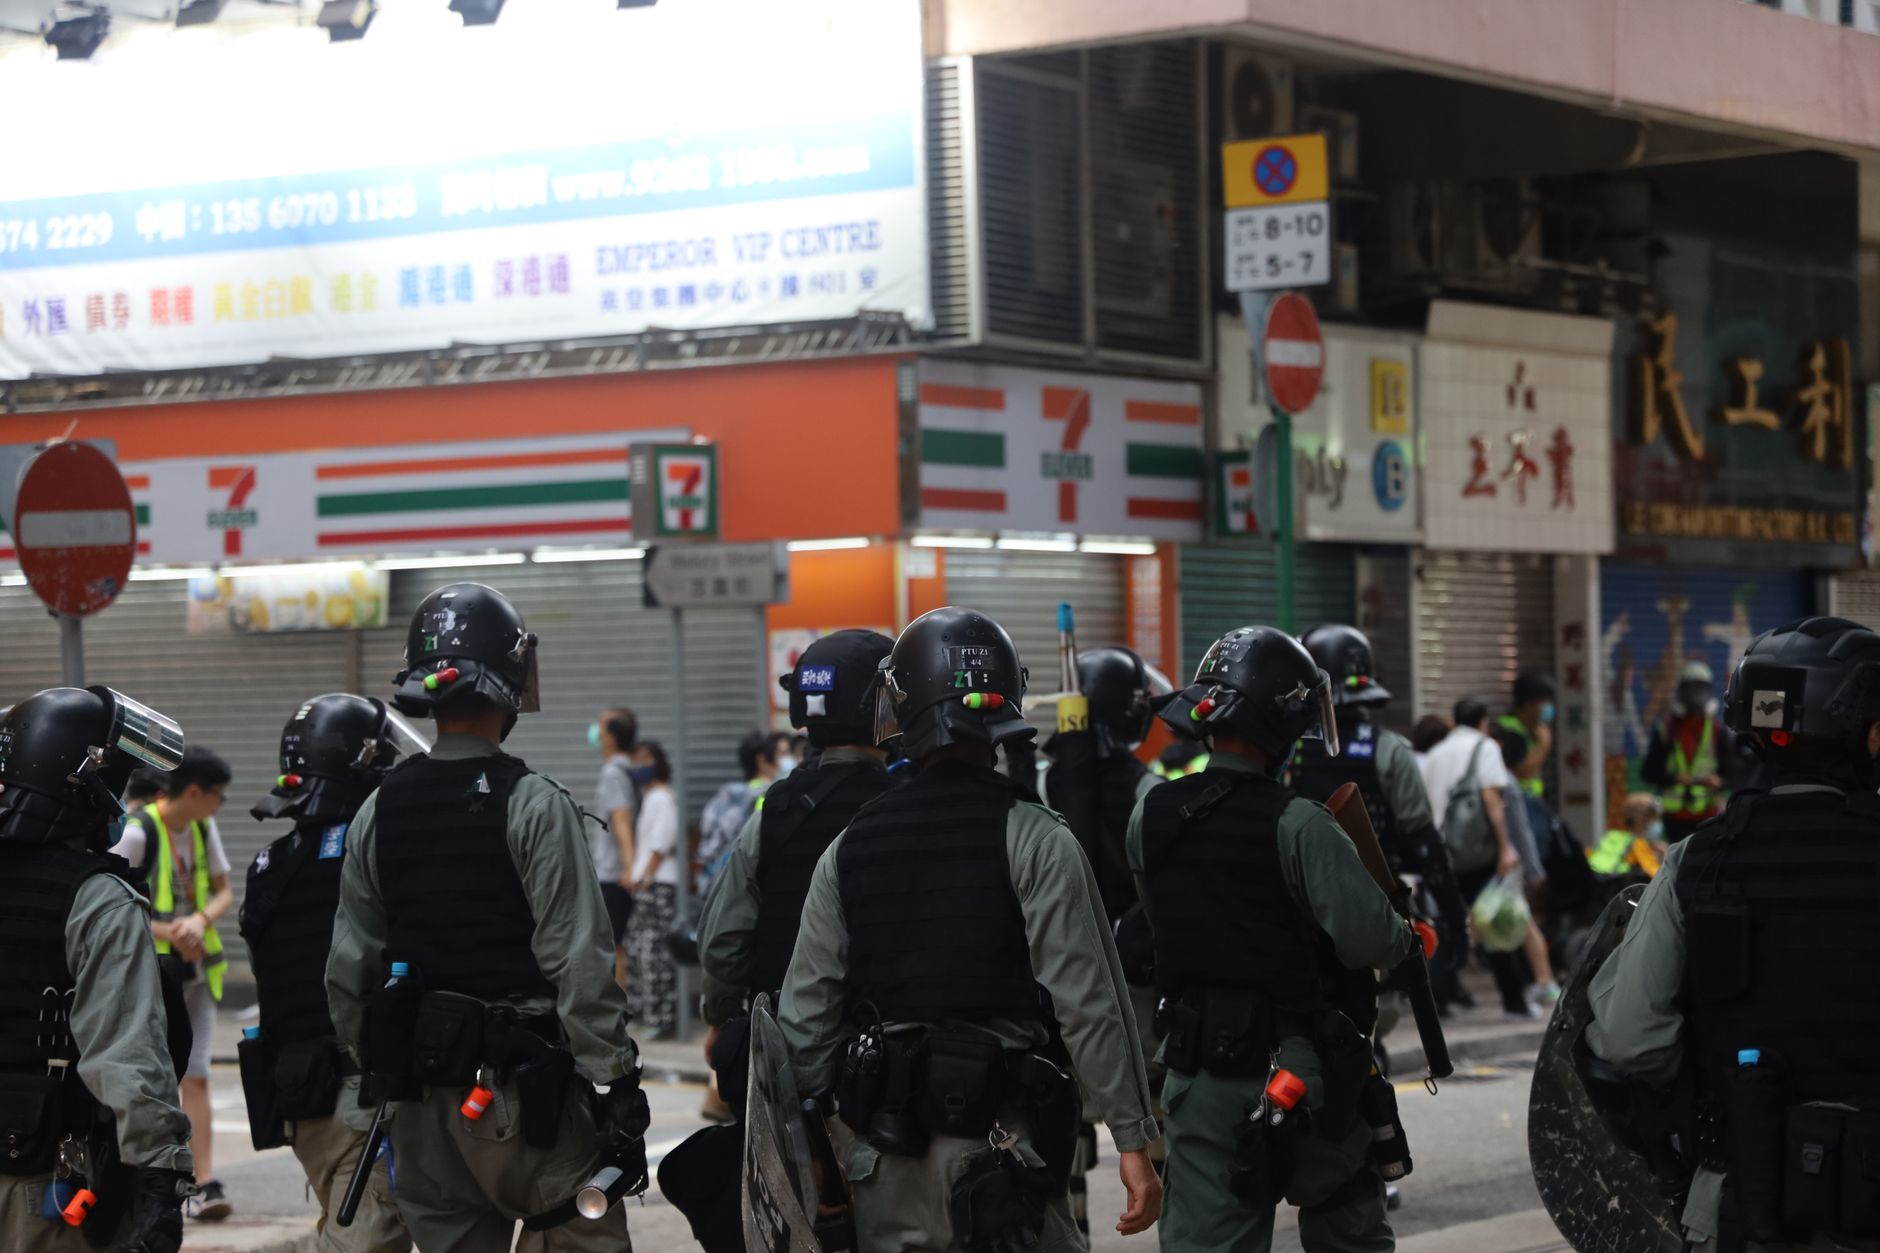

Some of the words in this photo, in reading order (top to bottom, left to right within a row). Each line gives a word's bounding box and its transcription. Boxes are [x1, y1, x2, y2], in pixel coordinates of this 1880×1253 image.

[595, 238, 716, 277] EMPEROR
[733, 231, 772, 262] VIP
[781, 219, 882, 258] CENTRE
[424, 634, 438, 651] Z1
[961, 648, 978, 656] PTU
[954, 670, 972, 688] Z1
